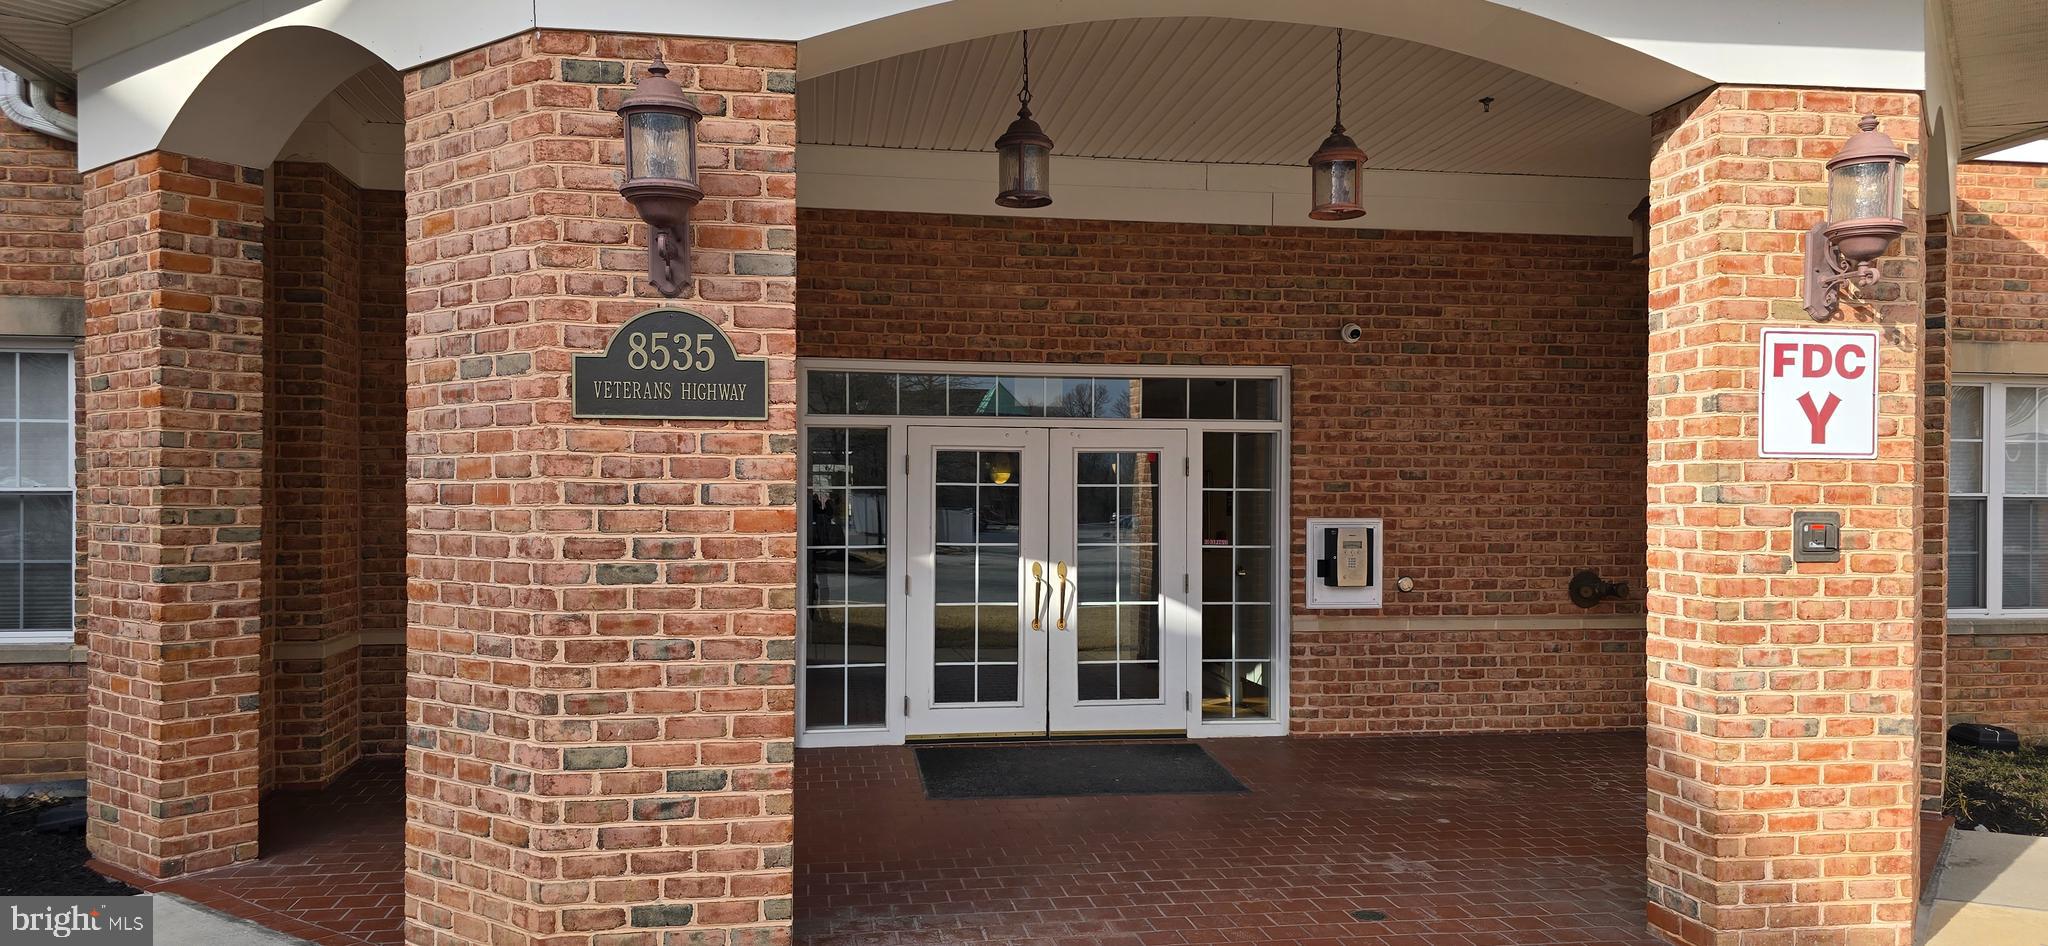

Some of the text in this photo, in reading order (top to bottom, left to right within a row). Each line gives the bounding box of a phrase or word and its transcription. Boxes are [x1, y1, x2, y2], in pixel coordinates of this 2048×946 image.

[627, 331, 716, 372] 8535
[1772, 342, 1866, 380] FDC
[593, 380, 747, 401] VETERANS HIGHWAY
[1796, 391, 1842, 445] Y
